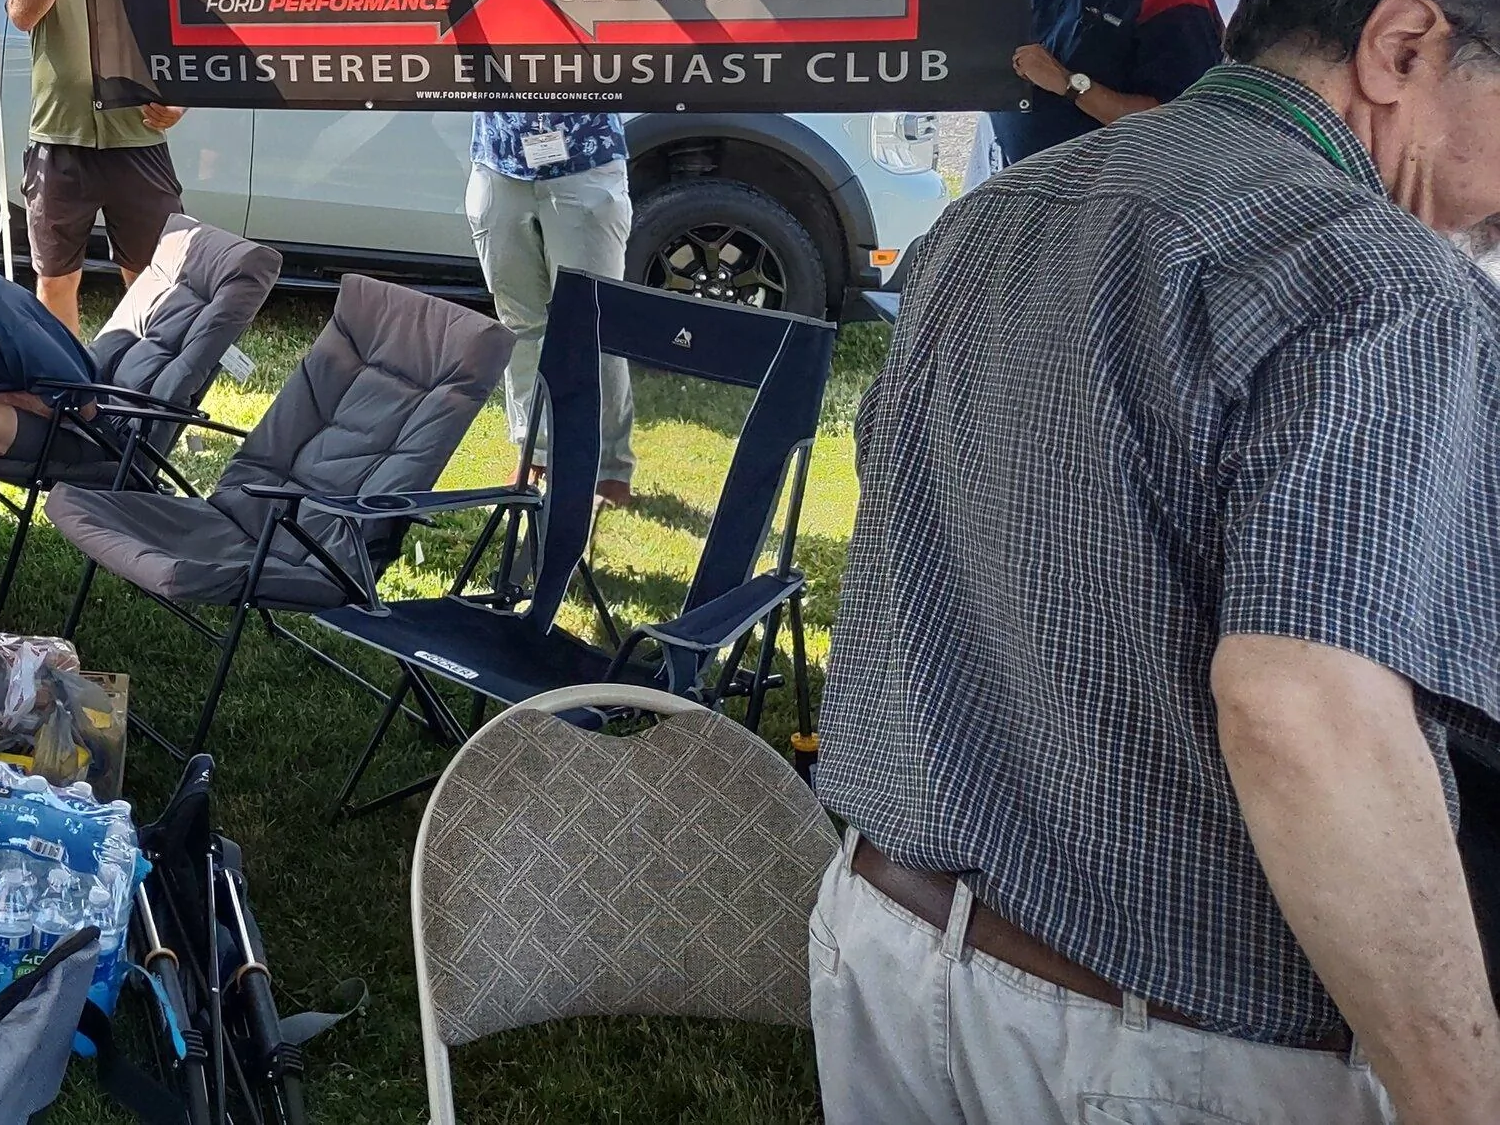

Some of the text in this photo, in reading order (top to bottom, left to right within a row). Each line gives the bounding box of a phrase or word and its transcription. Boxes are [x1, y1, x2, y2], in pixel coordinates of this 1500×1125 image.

[150, 49, 950, 84] REGISTERED ENTHUSIAST CLUB
[416, 90, 623, 101] WWW.FORDPERFORMANCECLUBCONNECT.COM
